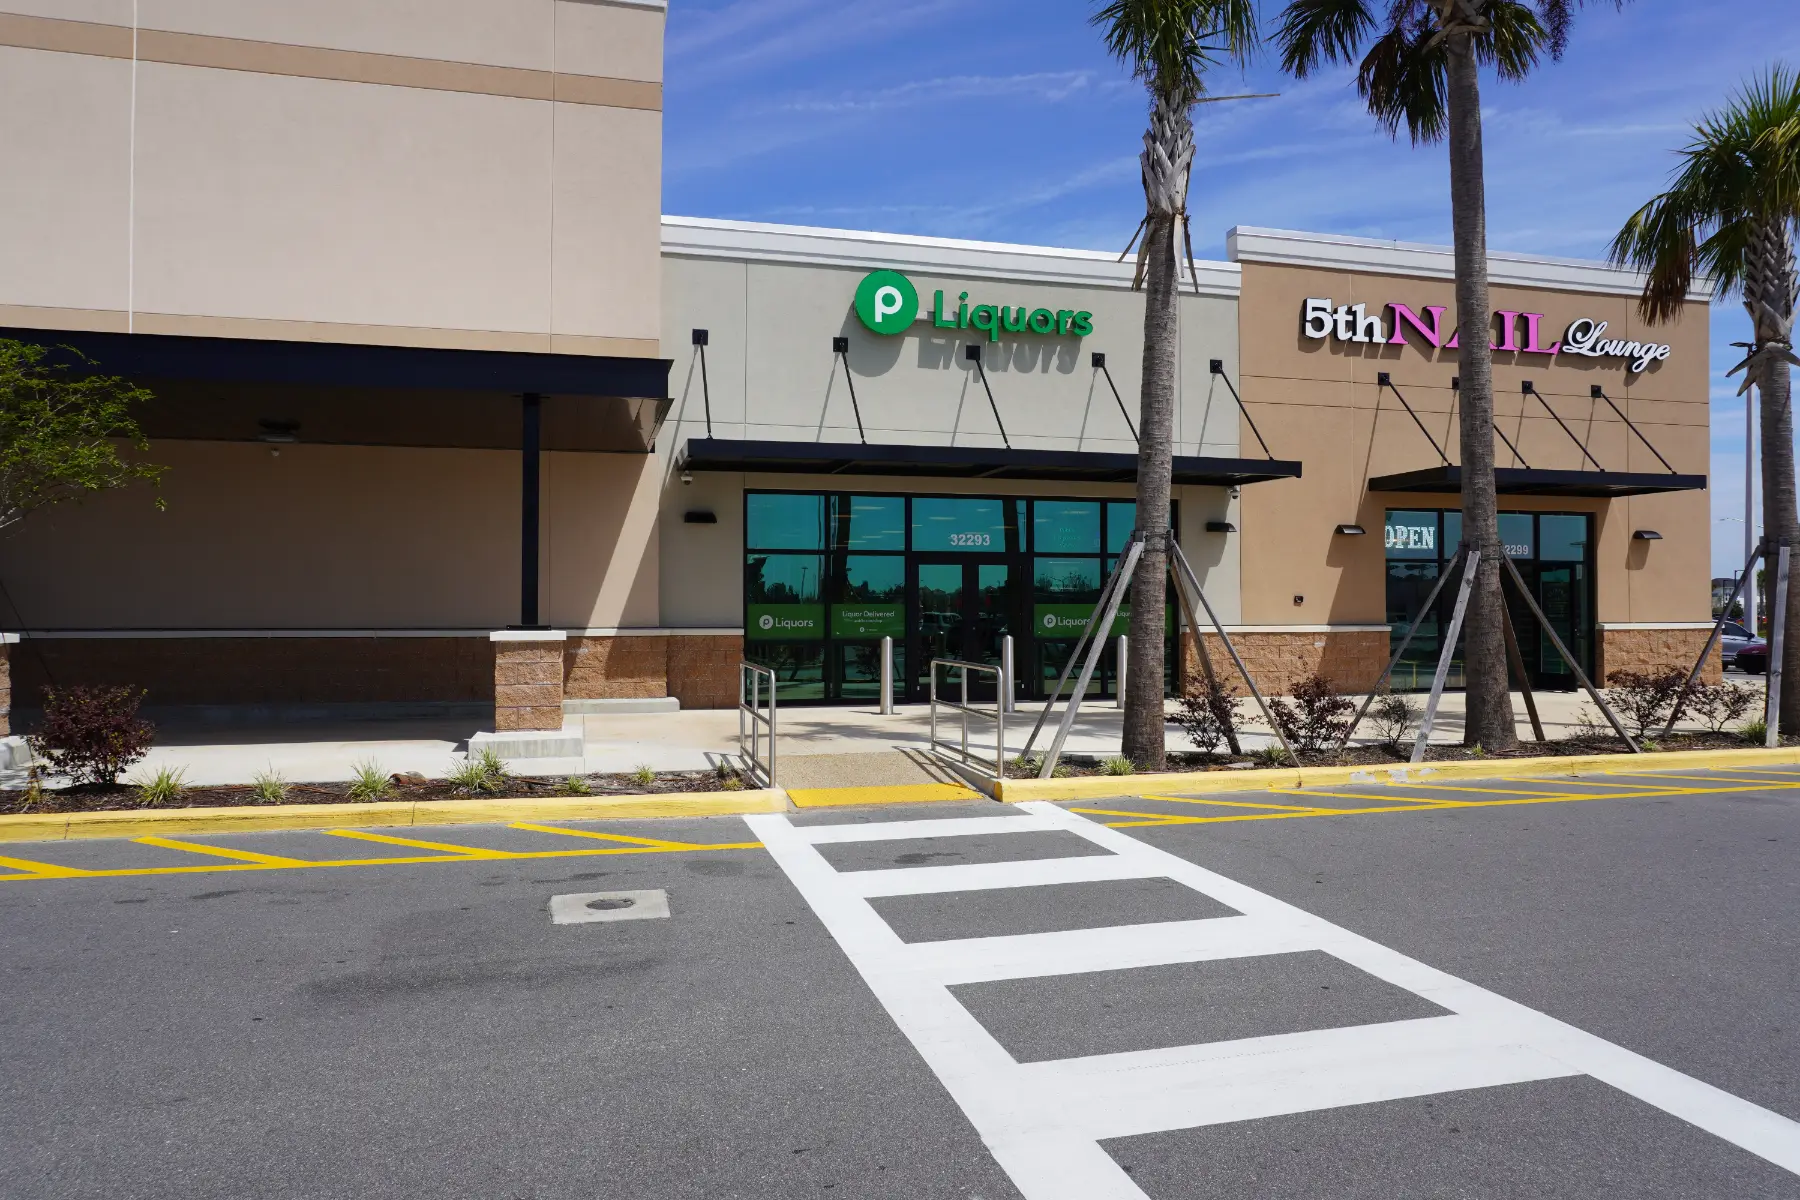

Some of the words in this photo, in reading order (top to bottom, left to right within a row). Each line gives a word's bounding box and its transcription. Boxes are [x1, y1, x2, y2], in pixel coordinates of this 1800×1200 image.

[933, 289, 1094, 343] Liquors
[1303, 297, 1388, 345] 5th
[1386, 302, 1561, 355] NIL
[1562, 317, 1671, 374] Lounge
[950, 533, 991, 546] 32293
[1384, 525, 1435, 550] OPEN
[1504, 544, 1529, 556] 2299
[842, 610, 862, 619] Liquor
[863, 610, 895, 618] Delivered
[775, 617, 814, 630] Liquors
